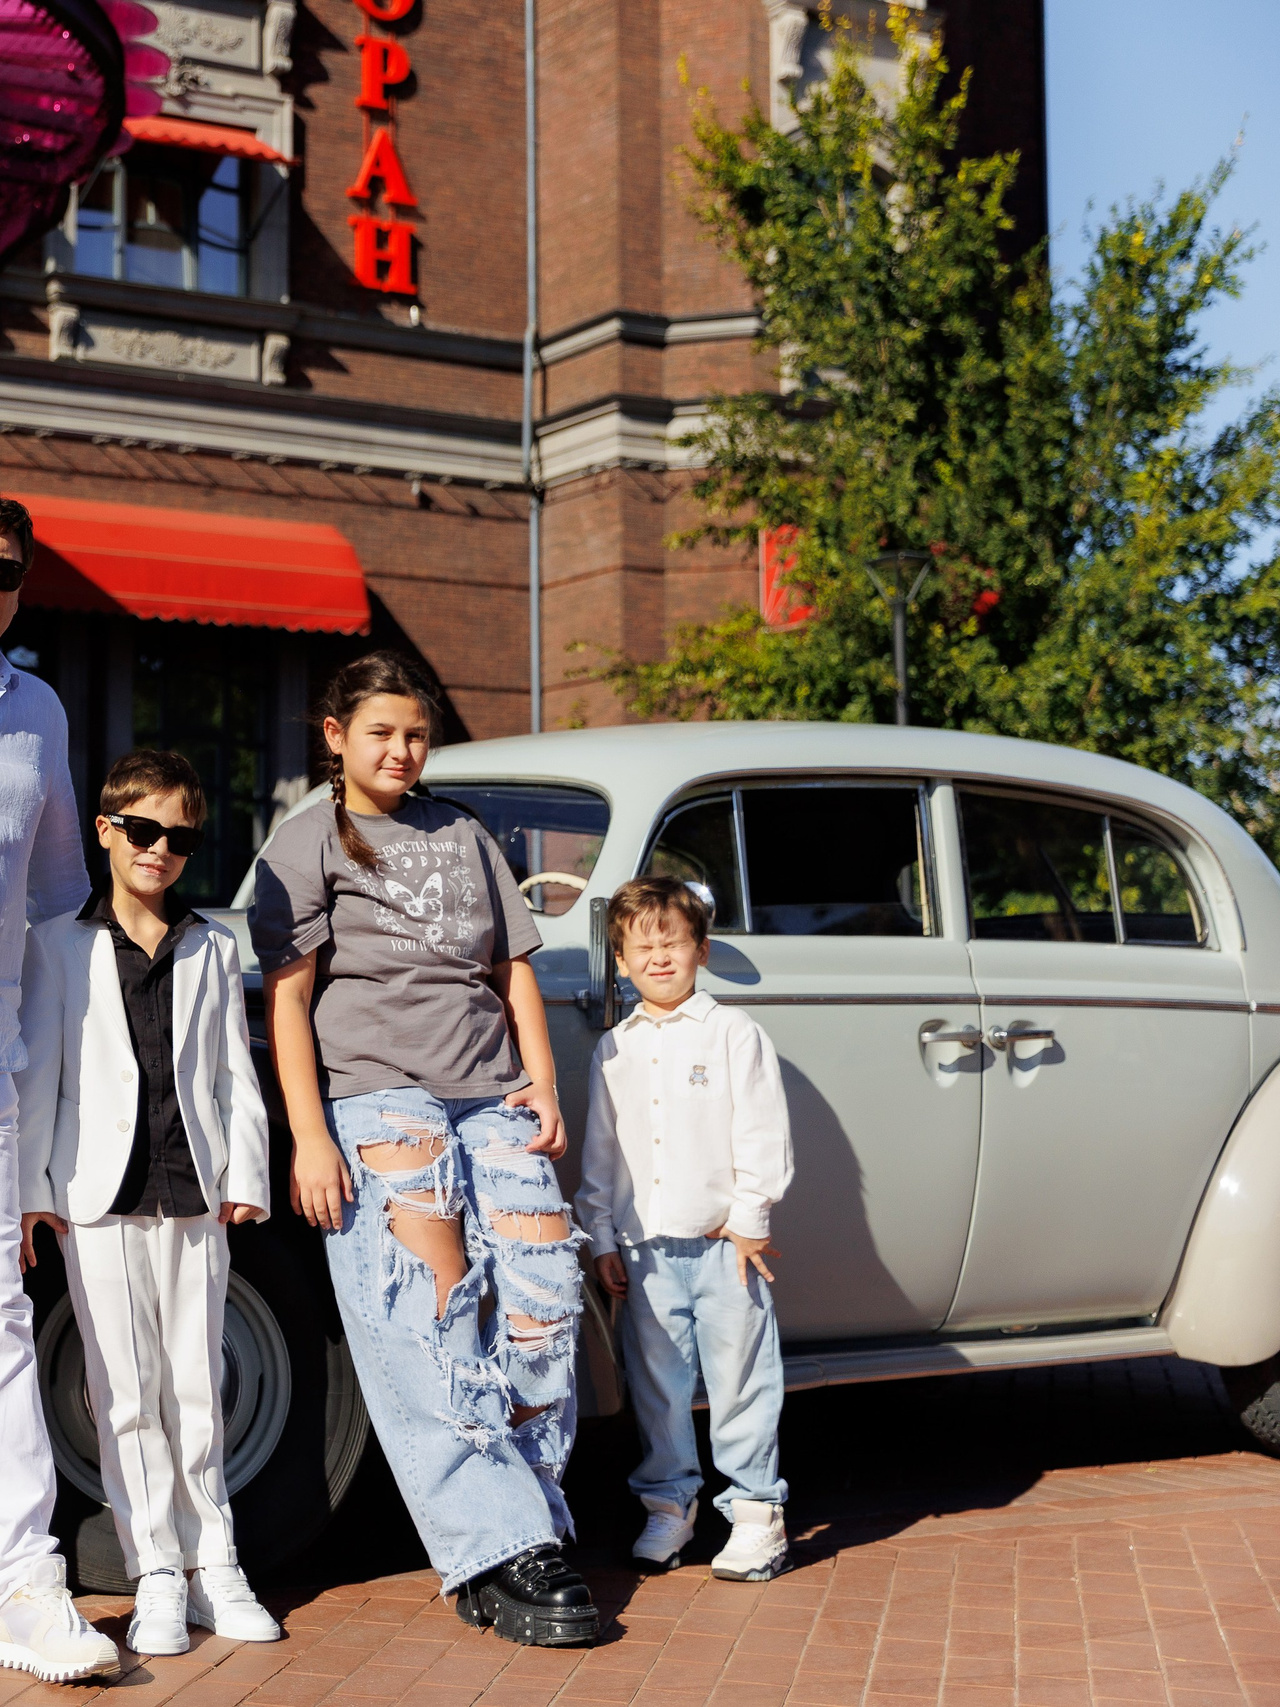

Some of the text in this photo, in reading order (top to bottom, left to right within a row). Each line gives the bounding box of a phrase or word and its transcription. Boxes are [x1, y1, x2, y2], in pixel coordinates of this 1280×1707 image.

[345, 0, 418, 296] РАН
[383, 841, 428, 858] EXACTLY
[390, 939, 416, 952] YOU
